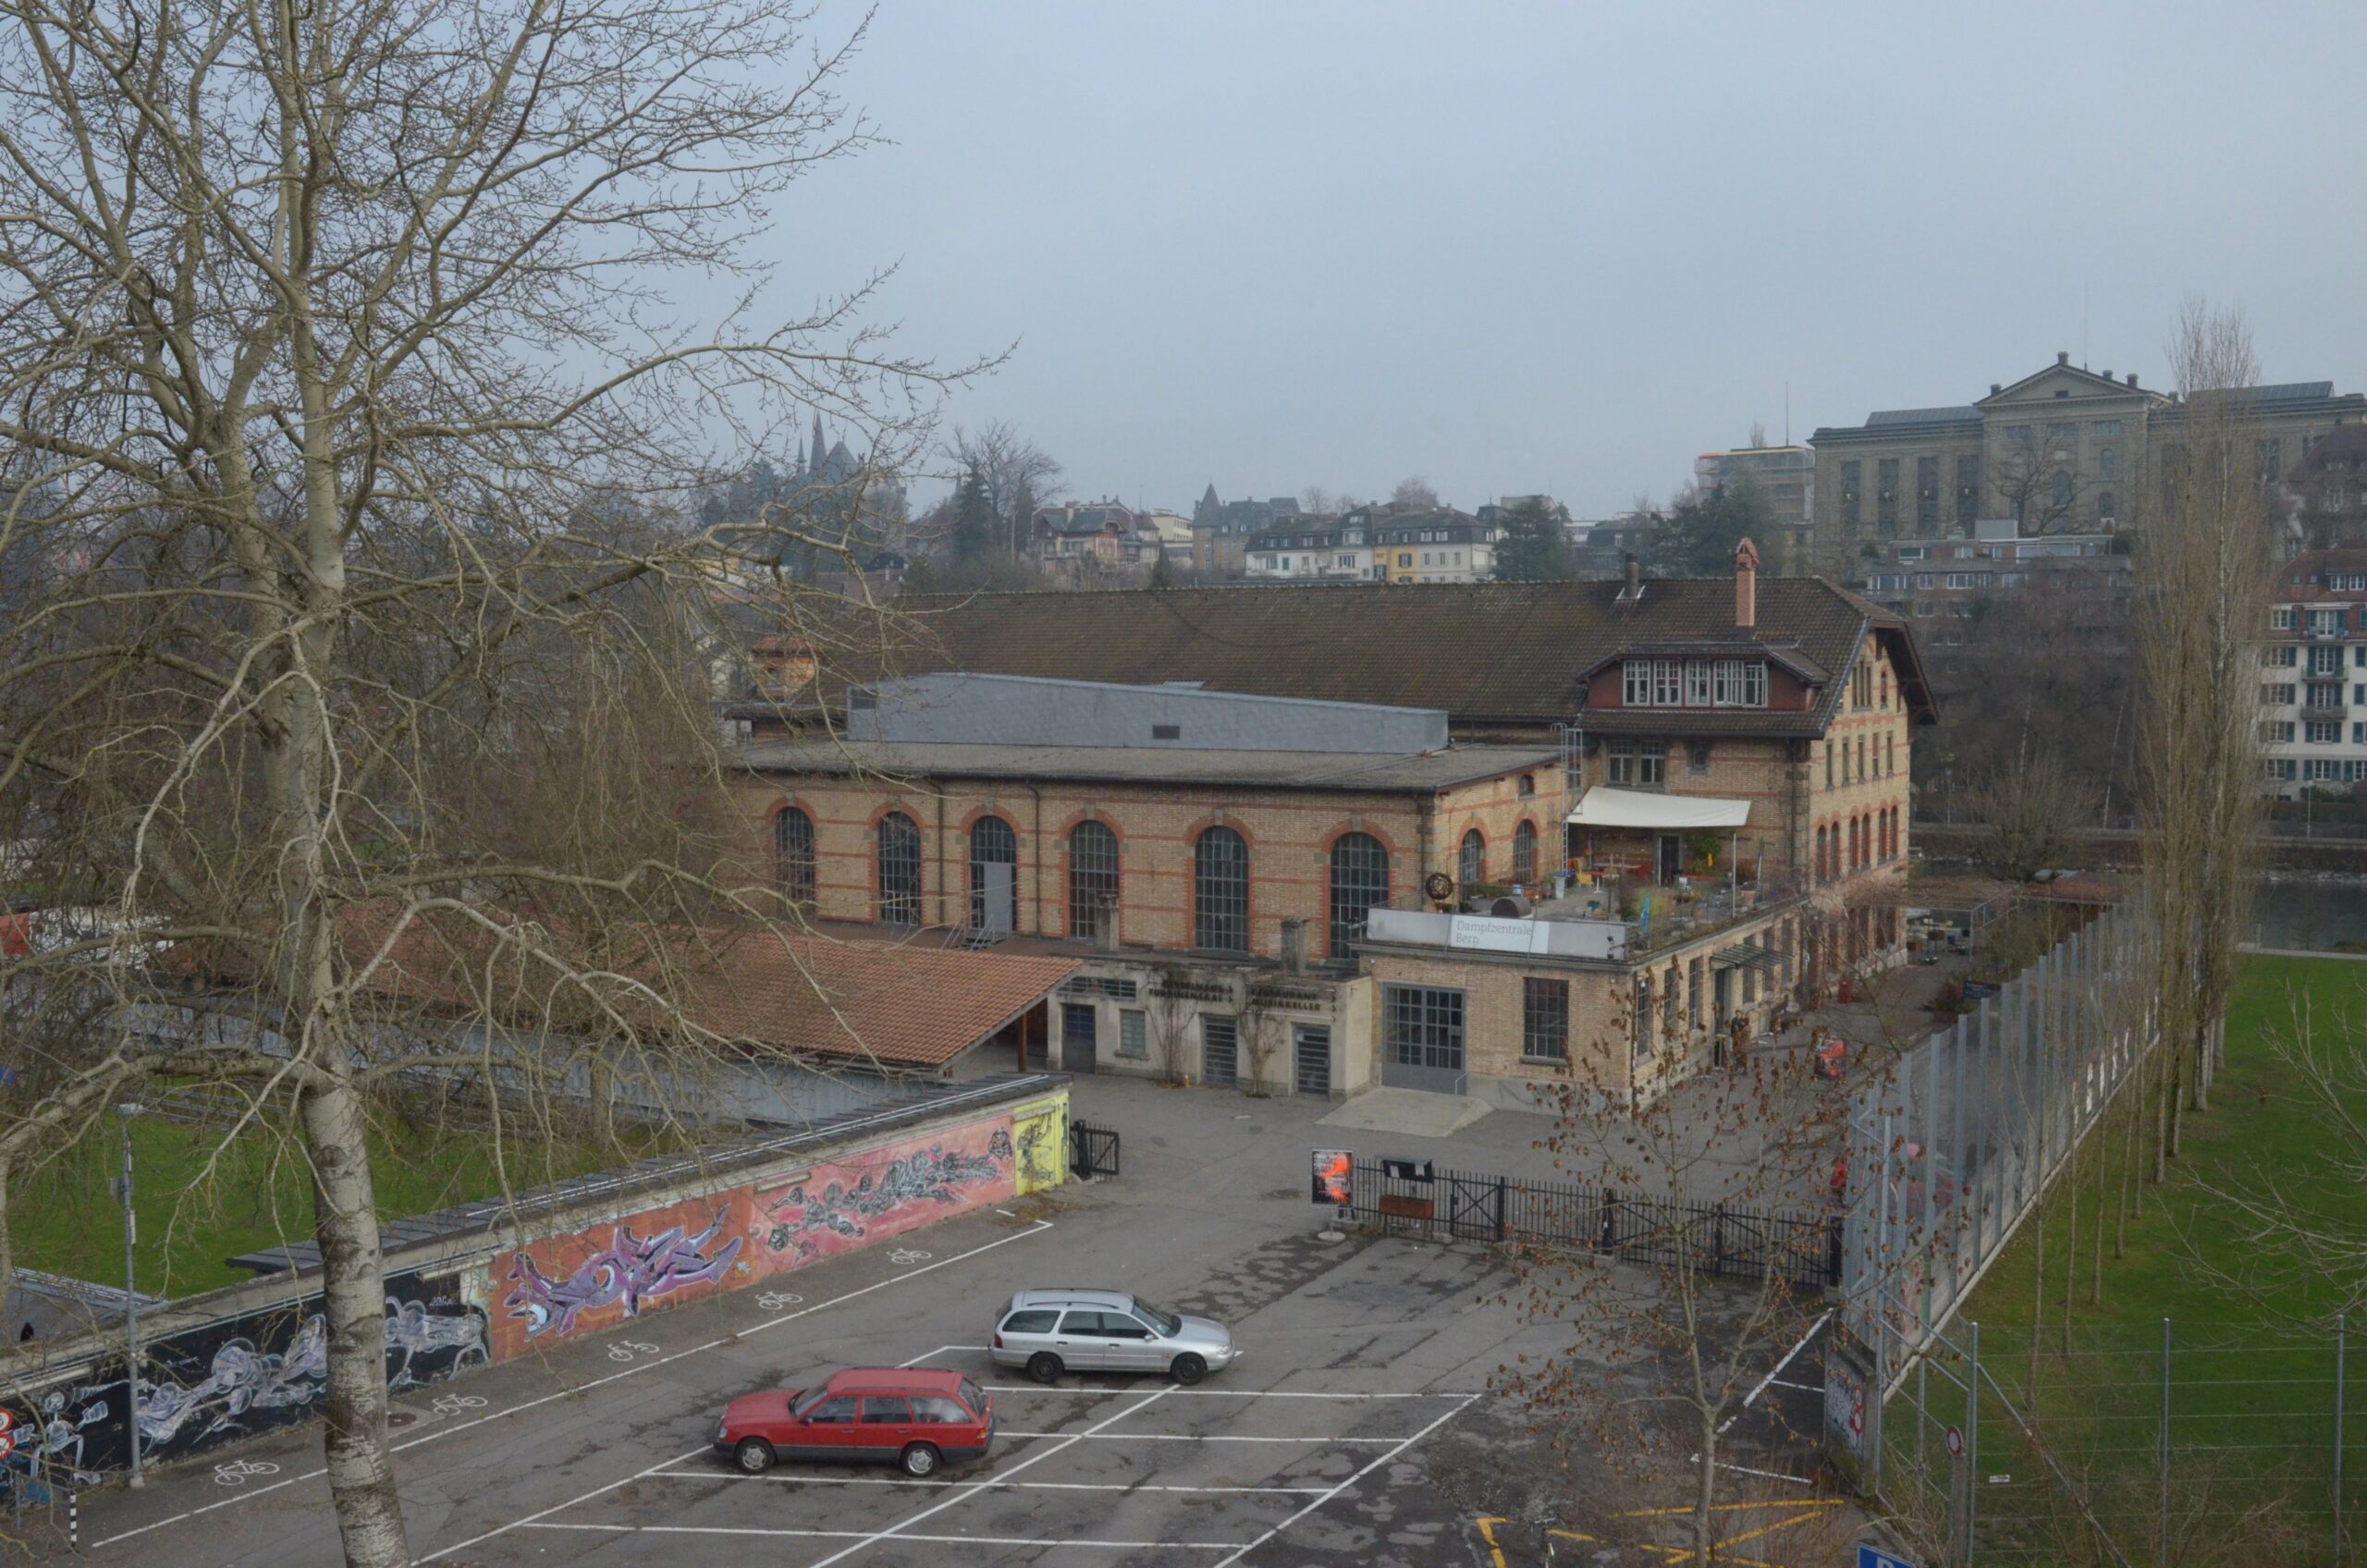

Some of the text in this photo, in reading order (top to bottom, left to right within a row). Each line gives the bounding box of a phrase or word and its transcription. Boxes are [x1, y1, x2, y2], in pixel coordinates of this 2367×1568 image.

[1456, 920, 1533, 936] Dampfzentrale
[1456, 933, 1479, 944] Bern
[1251, 998, 1320, 1011] MUSIKKELLER
